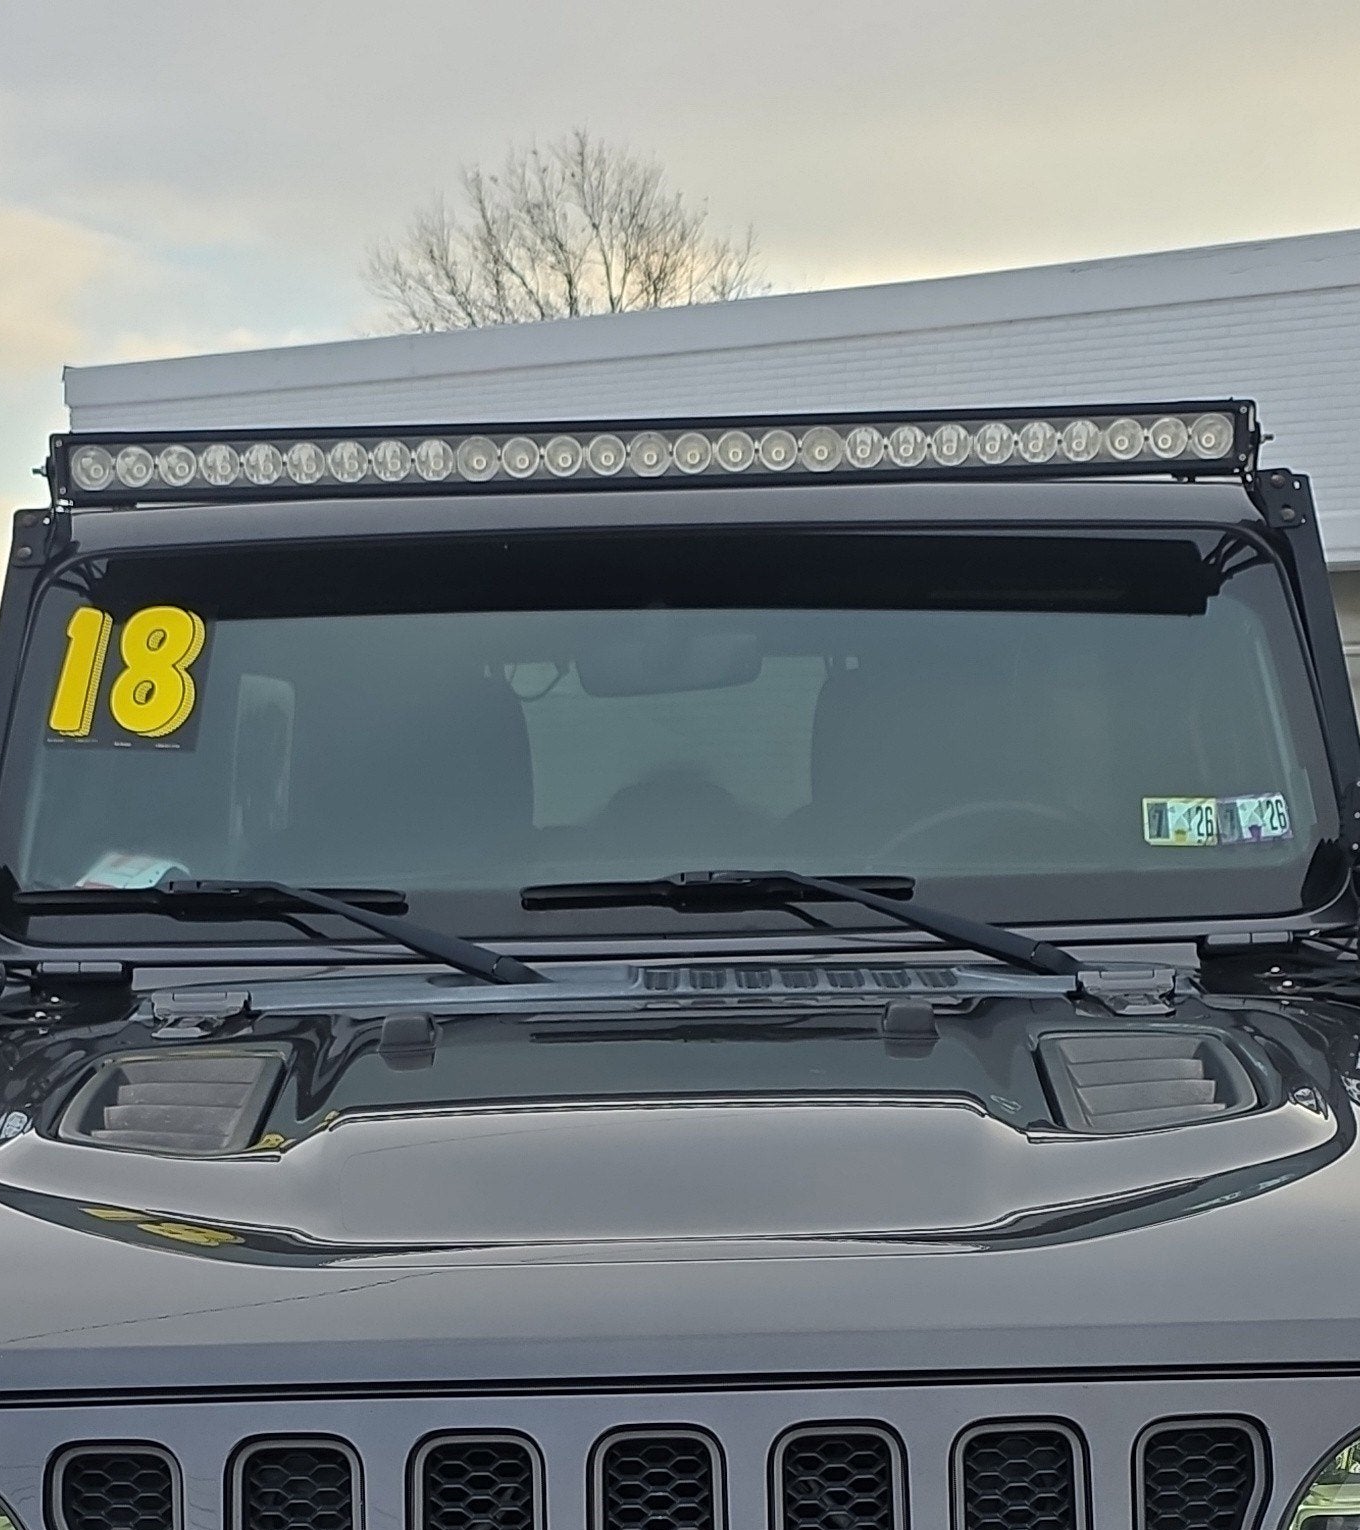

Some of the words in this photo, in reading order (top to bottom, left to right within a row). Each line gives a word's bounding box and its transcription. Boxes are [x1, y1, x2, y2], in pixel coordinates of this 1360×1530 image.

[48, 604, 207, 738] 18
[1195, 805, 1215, 837] 26
[1265, 799, 1288, 831] 26
